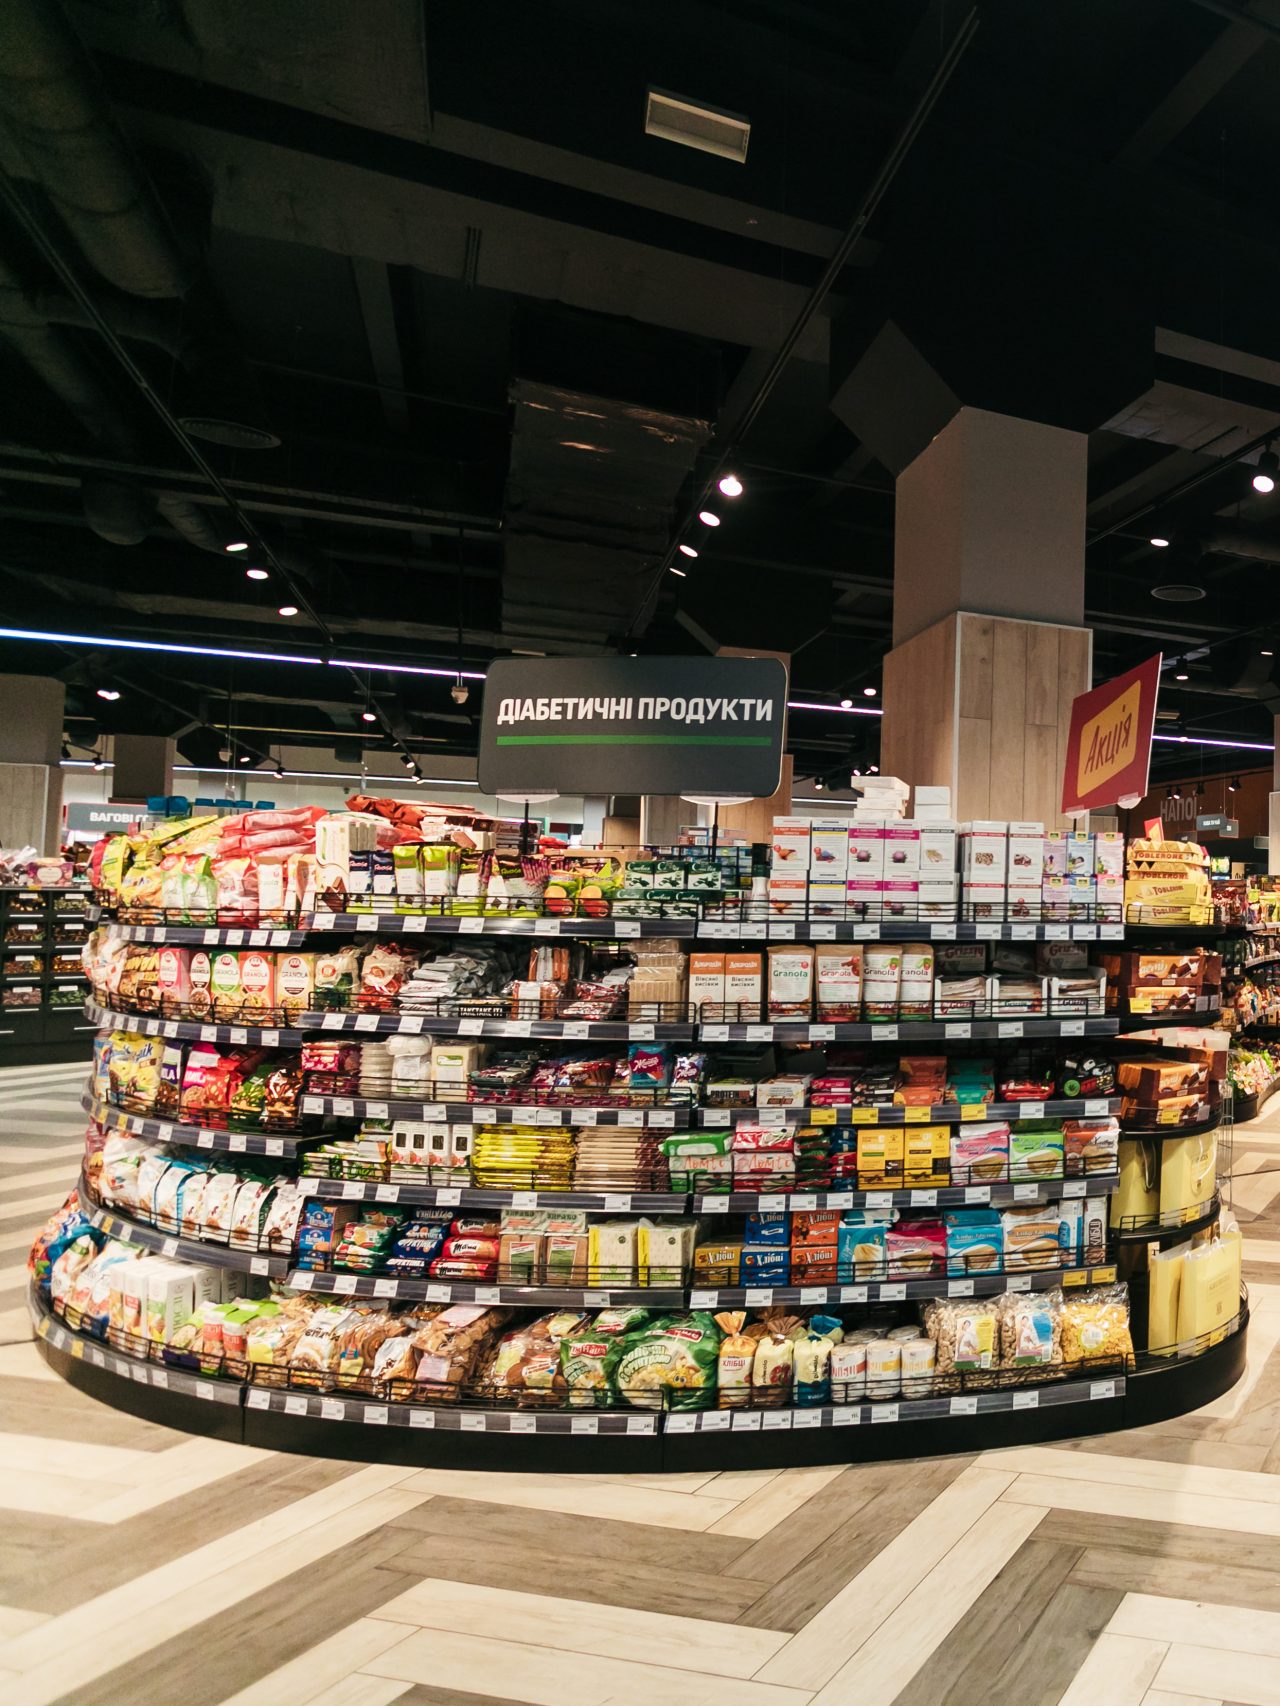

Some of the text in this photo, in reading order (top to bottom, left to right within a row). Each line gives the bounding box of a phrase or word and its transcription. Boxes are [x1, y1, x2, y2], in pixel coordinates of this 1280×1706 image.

[497, 698, 773, 726] ДІАБЕТИЧНІ ПРОДУКТИ
[1085, 704, 1132, 775] Акція
[90, 812, 133, 823] ВАГОВІ
[773, 970, 808, 978] Granola
[820, 970, 852, 978] Granola
[864, 968, 895, 976] Granola
[722, 1358, 746, 1368] ХЛІБЦІ
